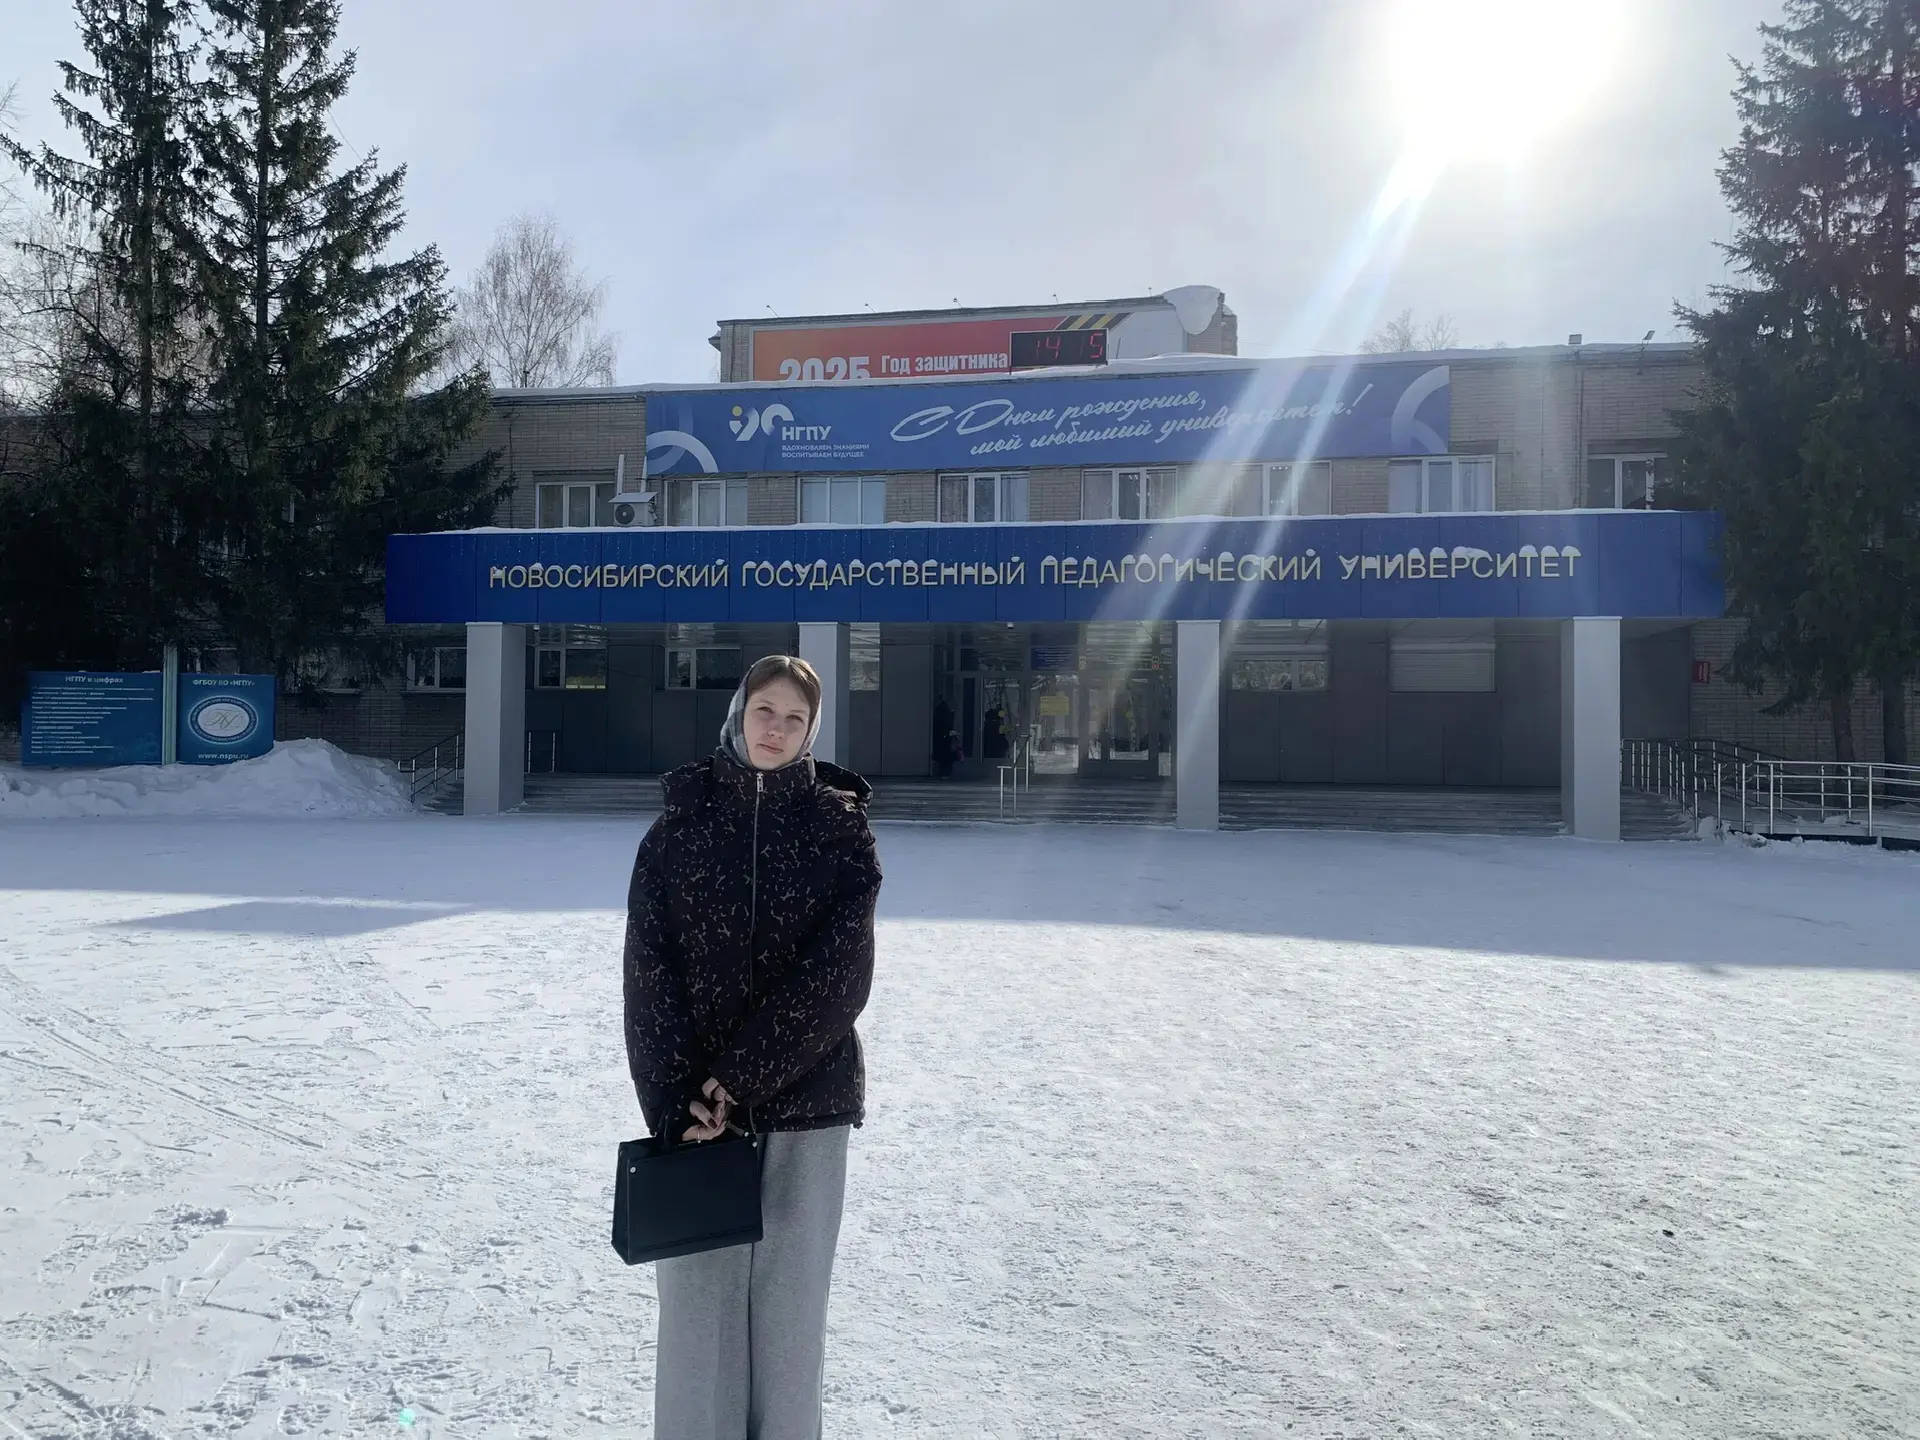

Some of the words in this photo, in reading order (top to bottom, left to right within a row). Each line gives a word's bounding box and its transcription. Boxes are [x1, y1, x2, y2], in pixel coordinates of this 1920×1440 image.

[779, 356, 873, 381] 2025
[881, 354, 911, 374] Год
[915, 352, 1008, 373] защитника
[890, 405, 954, 441] С
[954, 399, 1056, 435] Днем
[1054, 390, 1206, 430] рождения,
[781, 425, 832, 441] НГПУ
[833, 443, 870, 451] ЗНАНИЯМИ
[970, 434, 1023, 455] мой
[489, 560, 730, 588] НОВОСИБИРСКИЙ
[741, 557, 1025, 591] ГОСУДАРСТВЕННЫЙ
[1040, 550, 1321, 588] ПЕДАГОГИЧЕСКИЙ
[1338, 545, 1582, 580] УНИВЕРСИТЕТ
[93, 676, 124, 684] цифрах
